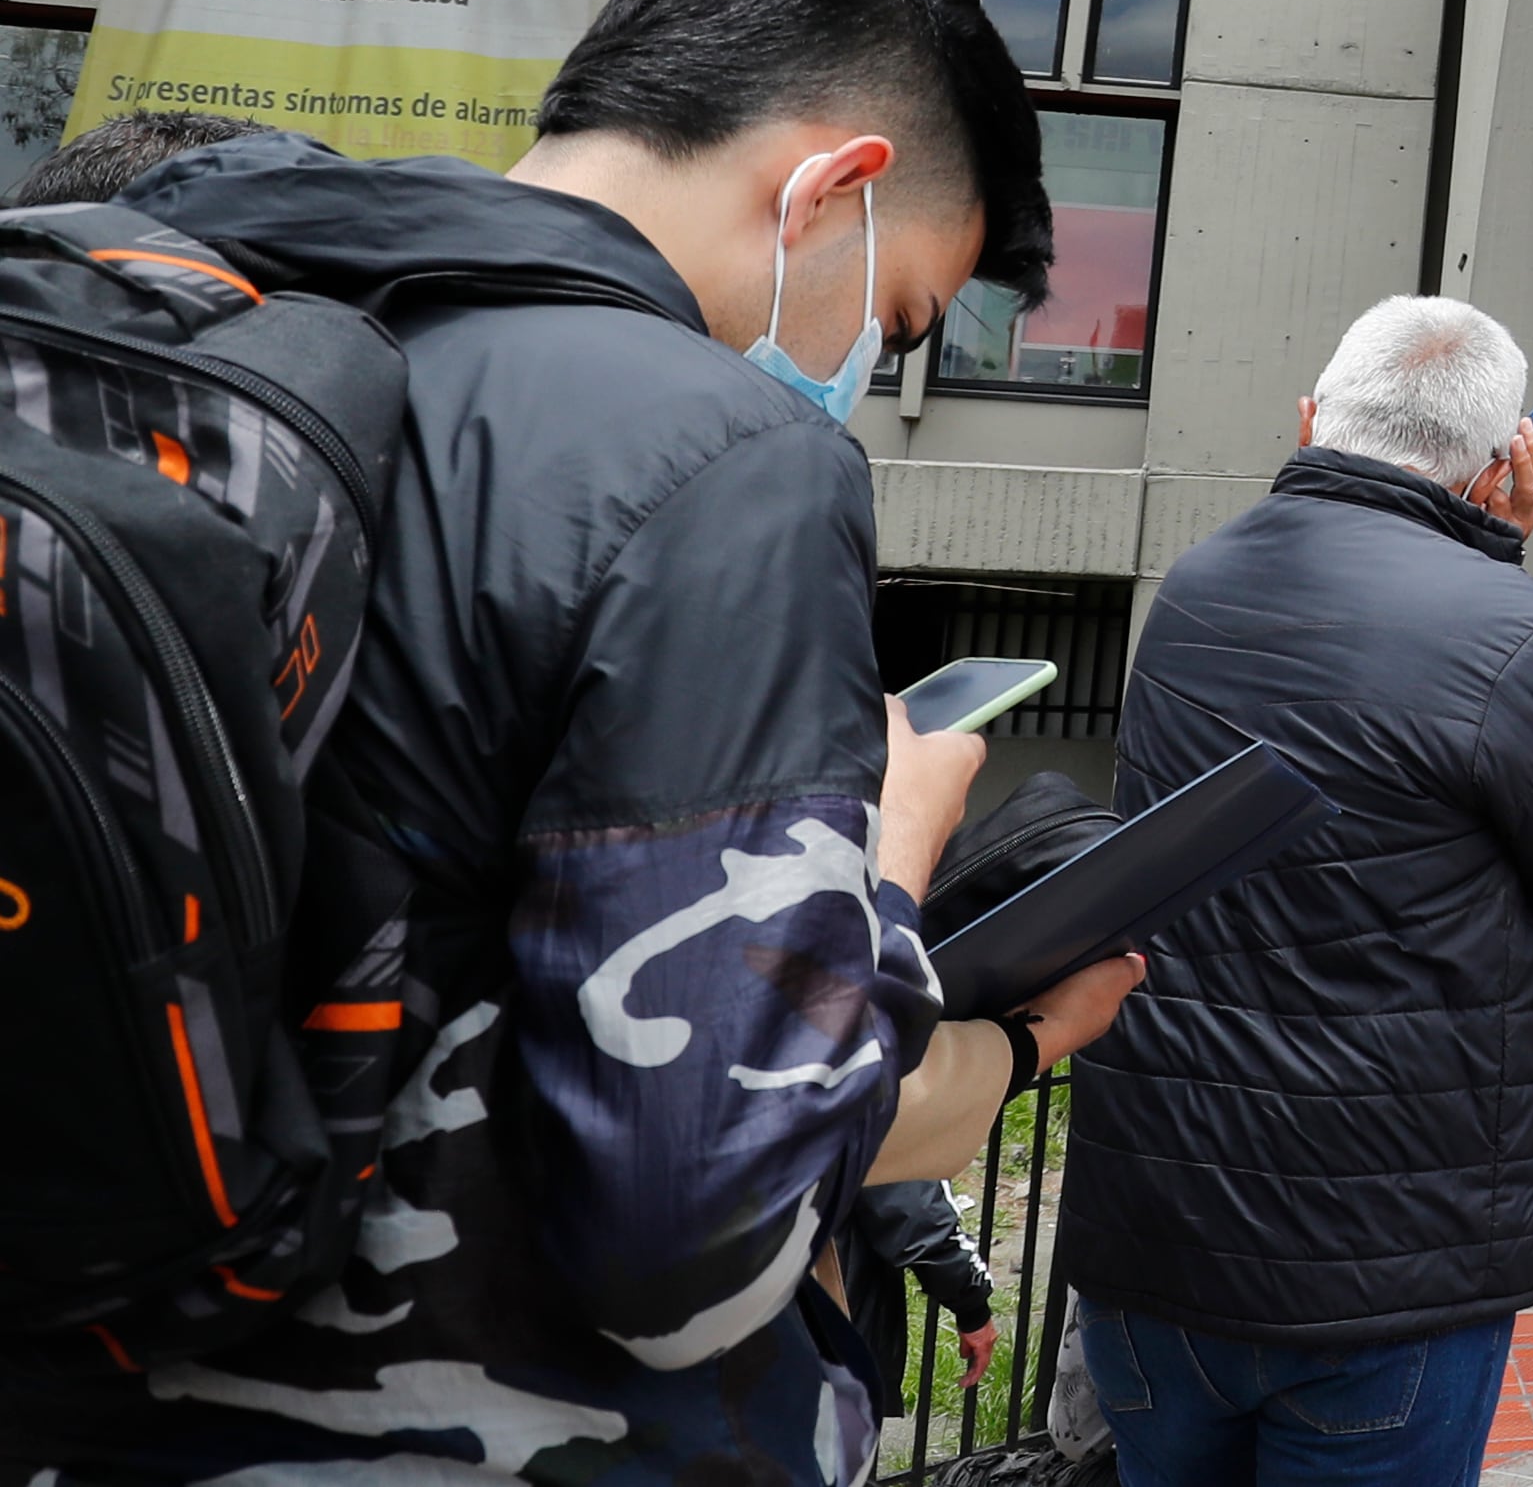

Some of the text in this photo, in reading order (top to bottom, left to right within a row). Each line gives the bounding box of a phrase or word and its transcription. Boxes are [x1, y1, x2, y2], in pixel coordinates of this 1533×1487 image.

[107, 74, 542, 129] Si presentas síntomas de alarma
